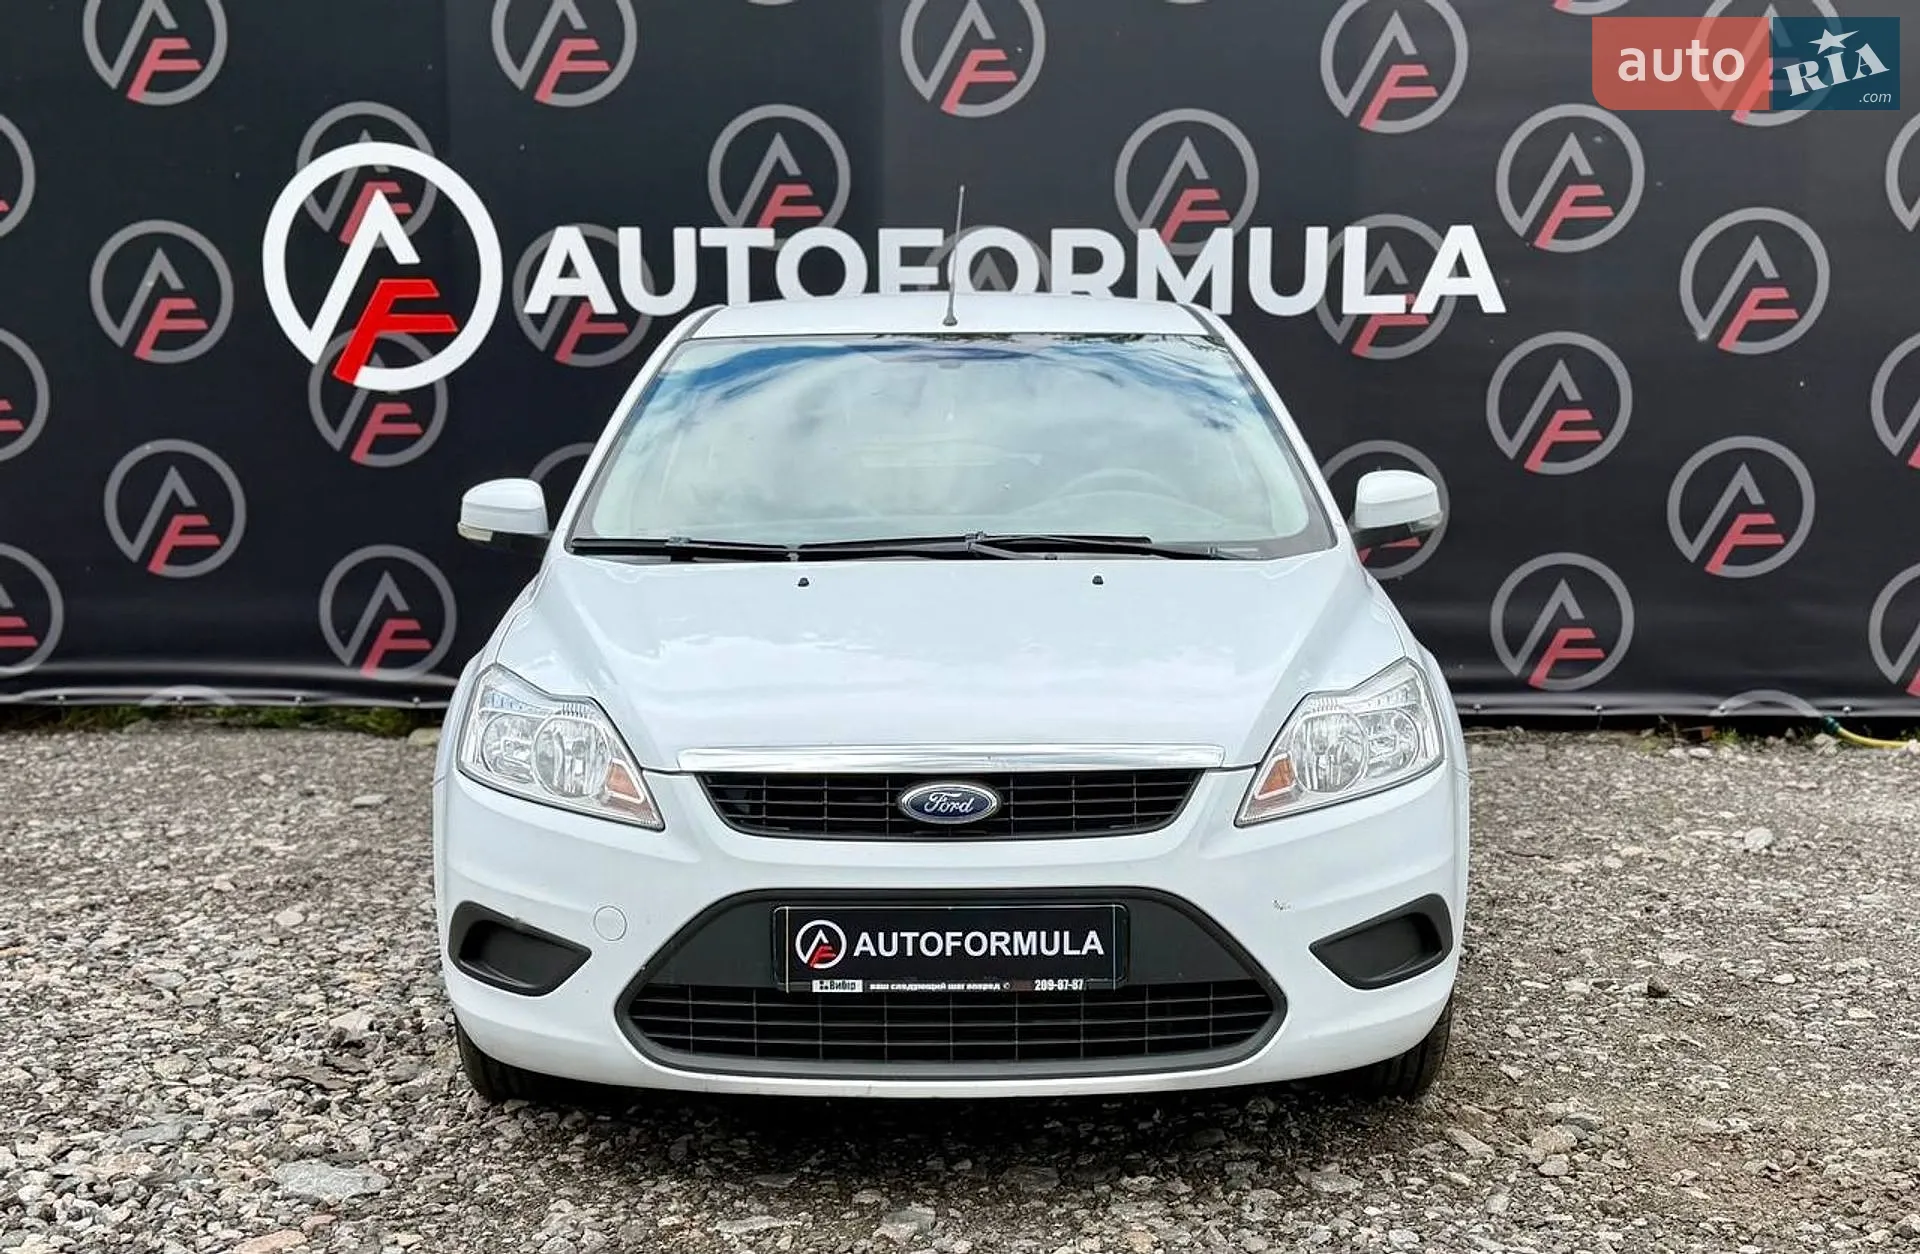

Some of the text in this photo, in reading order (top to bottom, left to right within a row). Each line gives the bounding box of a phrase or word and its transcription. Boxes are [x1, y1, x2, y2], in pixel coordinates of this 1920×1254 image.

[524, 224, 1507, 317] AUTOFORMULA
[924, 792, 975, 813] Ford
[853, 930, 1104, 957] AUTOFORMULA
